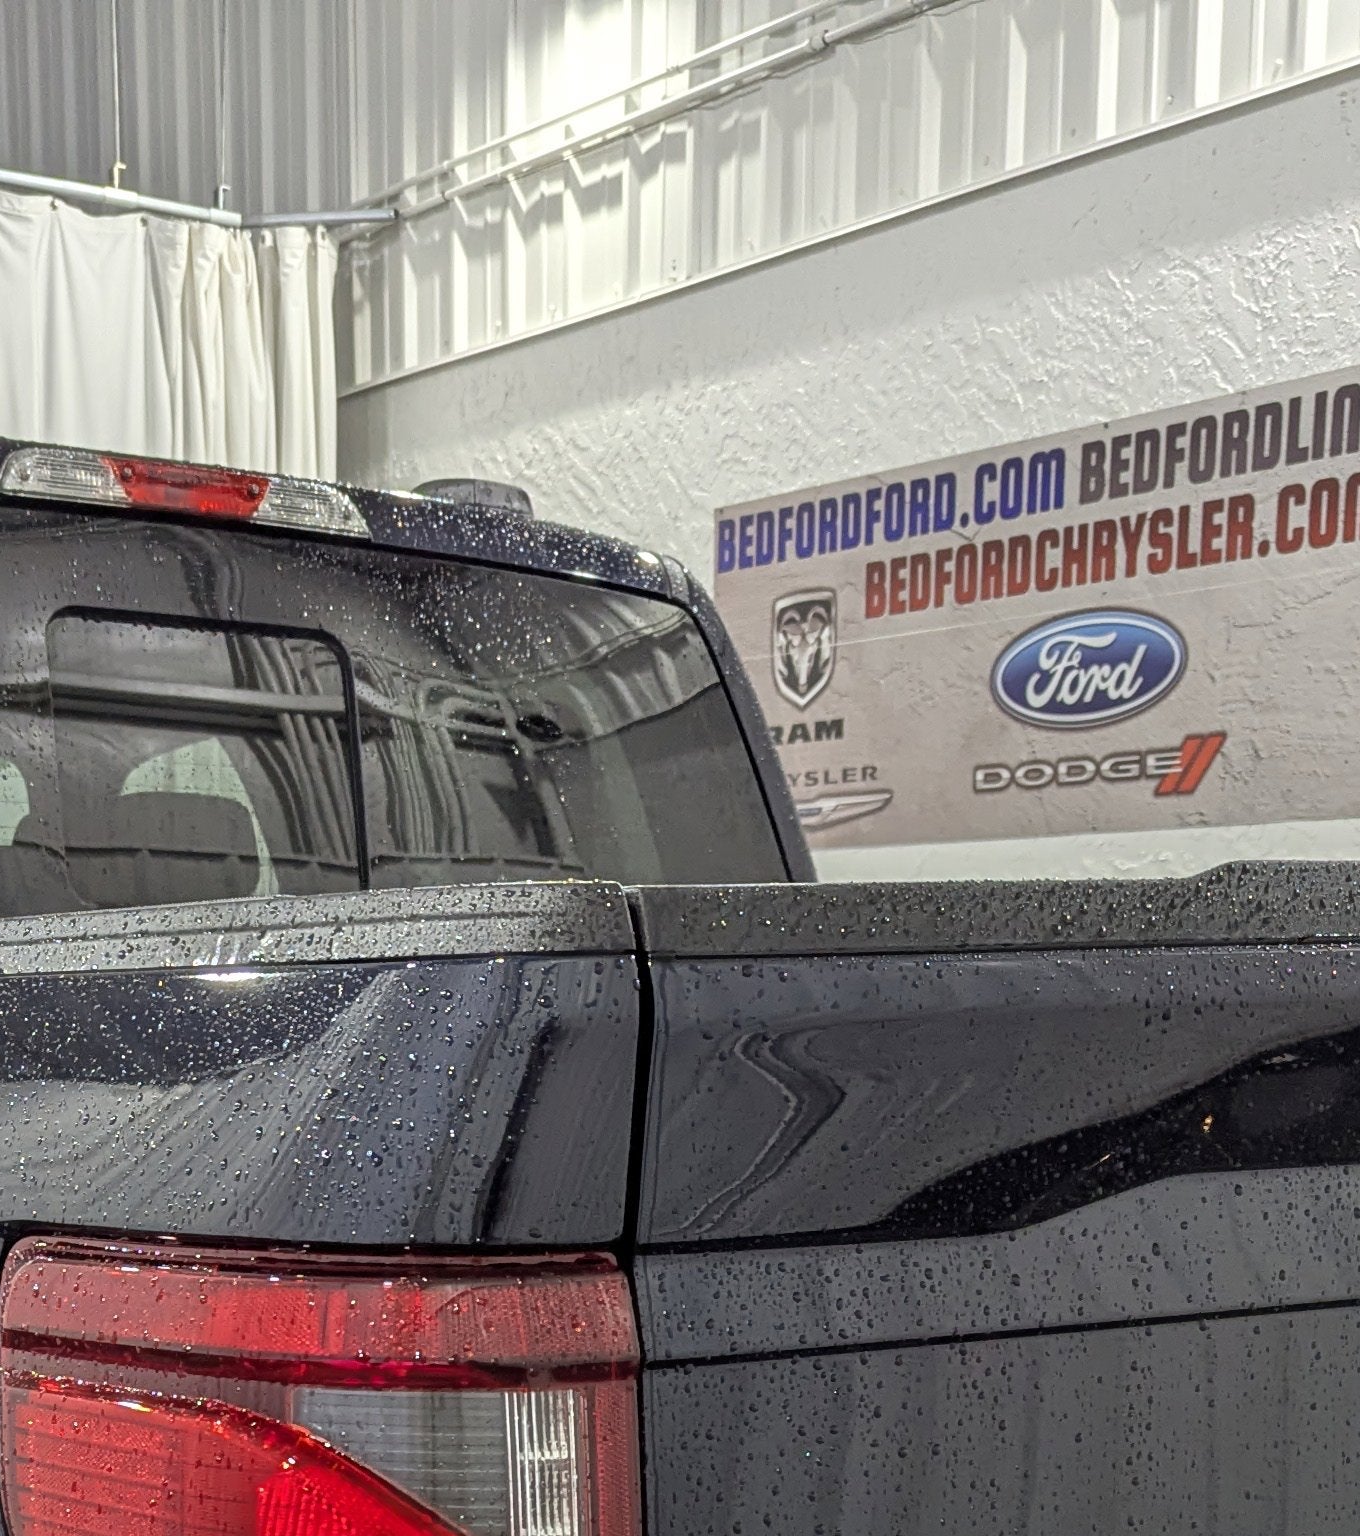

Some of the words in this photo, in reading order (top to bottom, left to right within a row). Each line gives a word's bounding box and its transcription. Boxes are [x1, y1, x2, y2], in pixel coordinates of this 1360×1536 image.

[717, 447, 1066, 574] BEDFORDFORD.COM
[1025, 631, 1148, 708] Ford
[787, 765, 878, 788] YSLER
[973, 746, 1184, 793] DODGE
